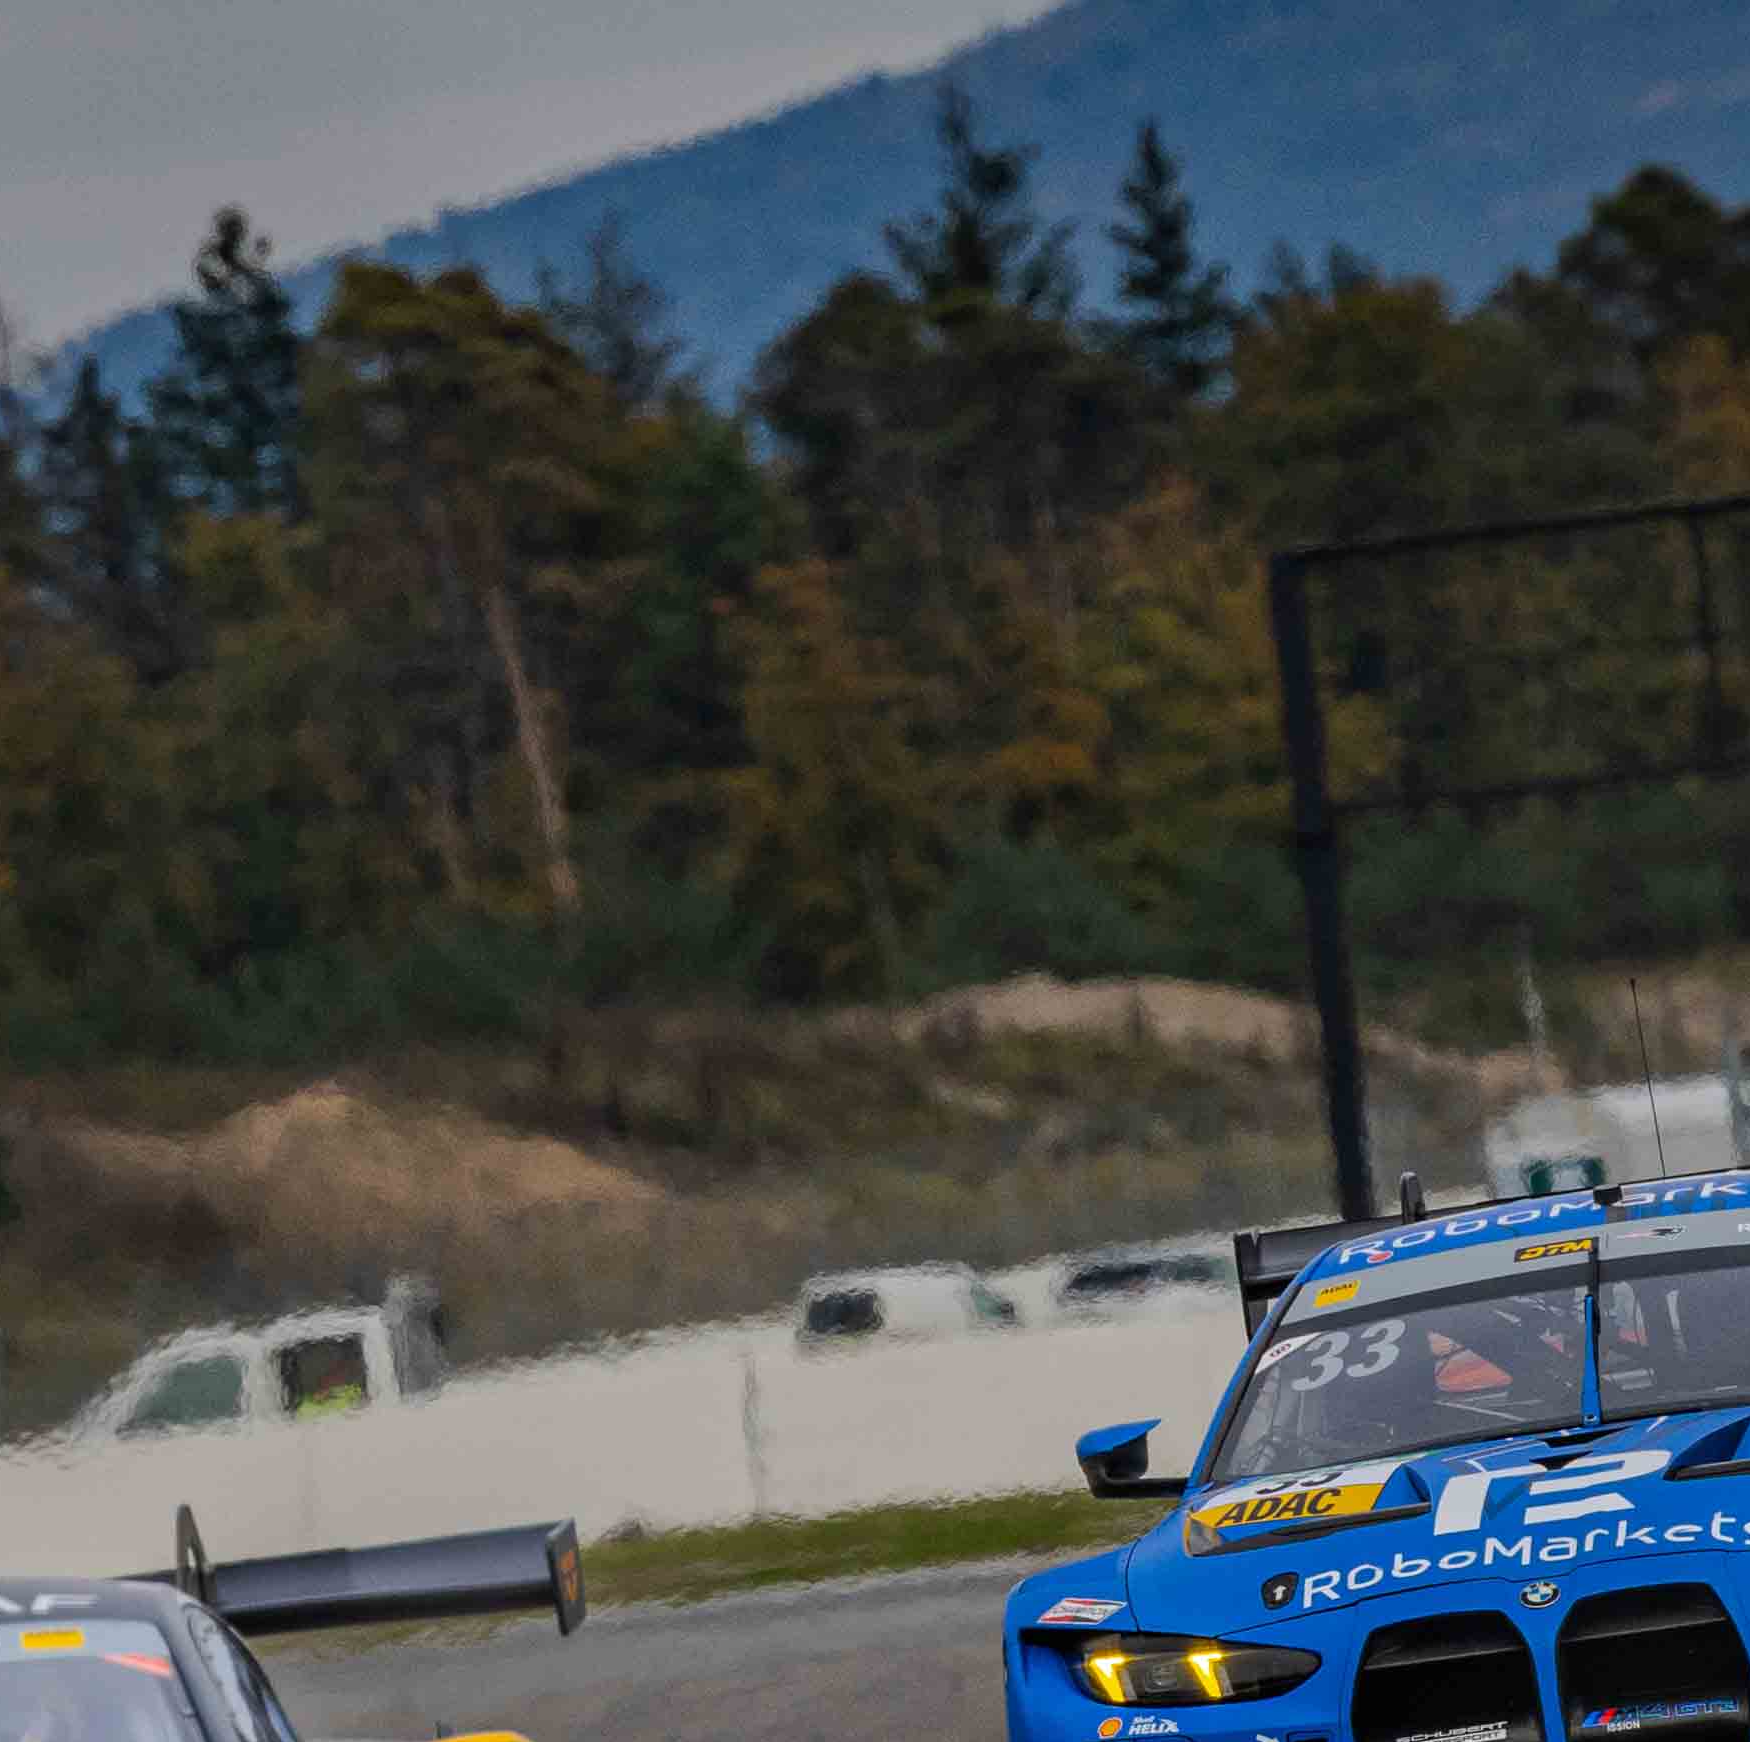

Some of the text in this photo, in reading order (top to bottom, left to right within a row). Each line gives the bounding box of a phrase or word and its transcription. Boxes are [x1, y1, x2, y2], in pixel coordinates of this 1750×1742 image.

[1519, 1239, 1594, 1261] DTM
[1292, 1319, 1406, 1391] 33
[1216, 1487, 1343, 1527] ADAC
